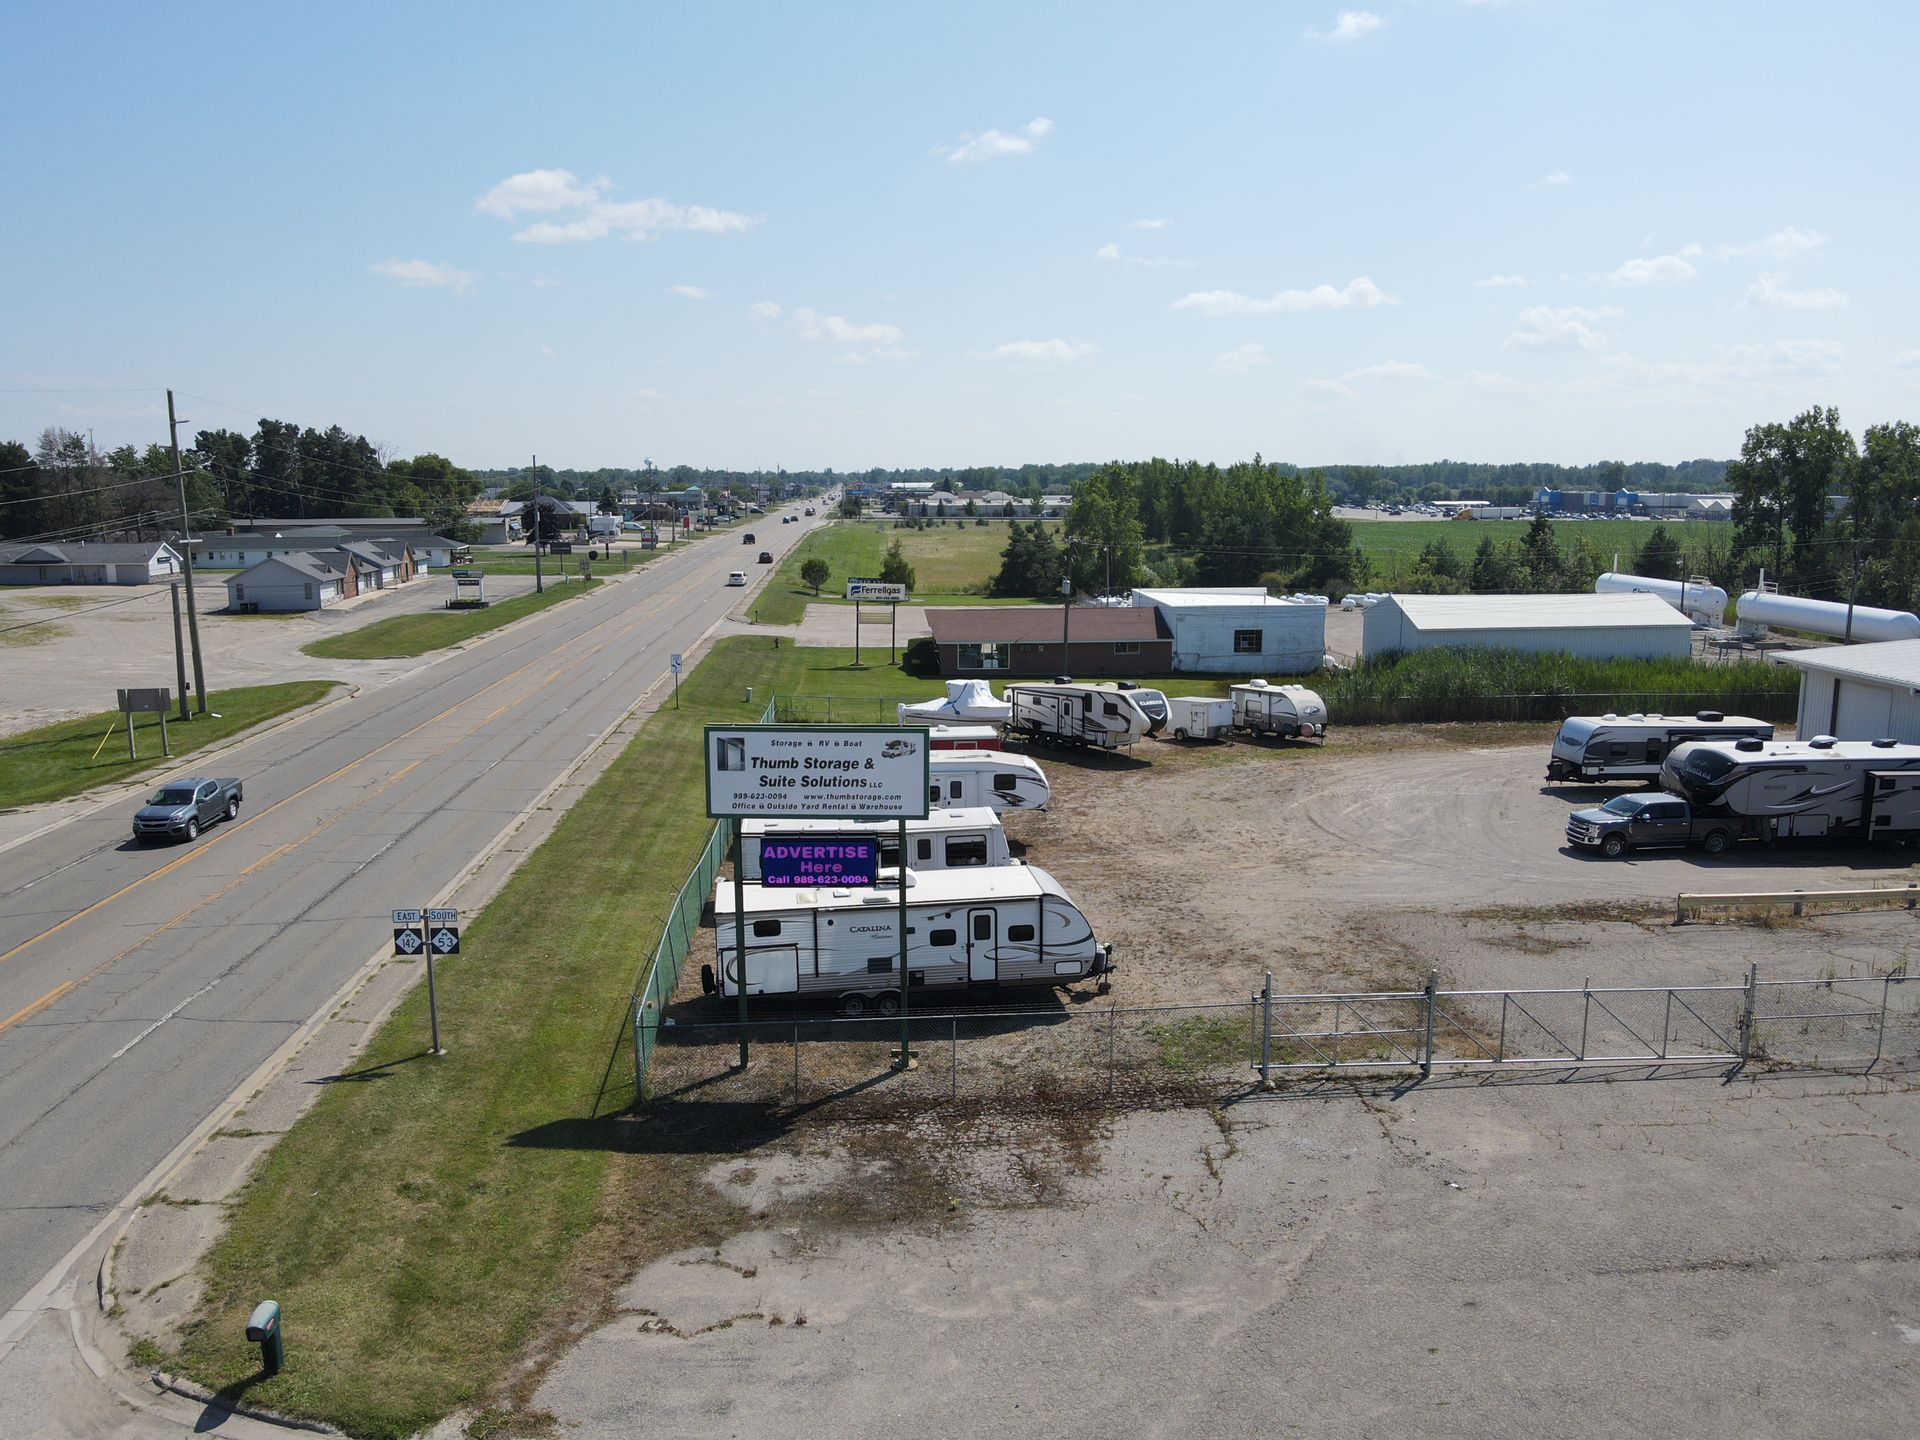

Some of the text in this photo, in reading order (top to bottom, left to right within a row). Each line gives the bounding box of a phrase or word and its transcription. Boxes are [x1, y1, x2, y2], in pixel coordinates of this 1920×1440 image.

[862, 586, 900, 596] Ferrellgas
[751, 757, 875, 771] Thumb Storage &
[759, 776, 796, 787] Suite
[801, 776, 867, 787] Solutions
[764, 846, 868, 859] ADVERTISE
[800, 862, 842, 873] Here
[794, 875, 869, 884] 989-623-0094
[431, 911, 456, 919] SOUTH
[402, 939, 415, 948] 142
[438, 938, 453, 947] 53
